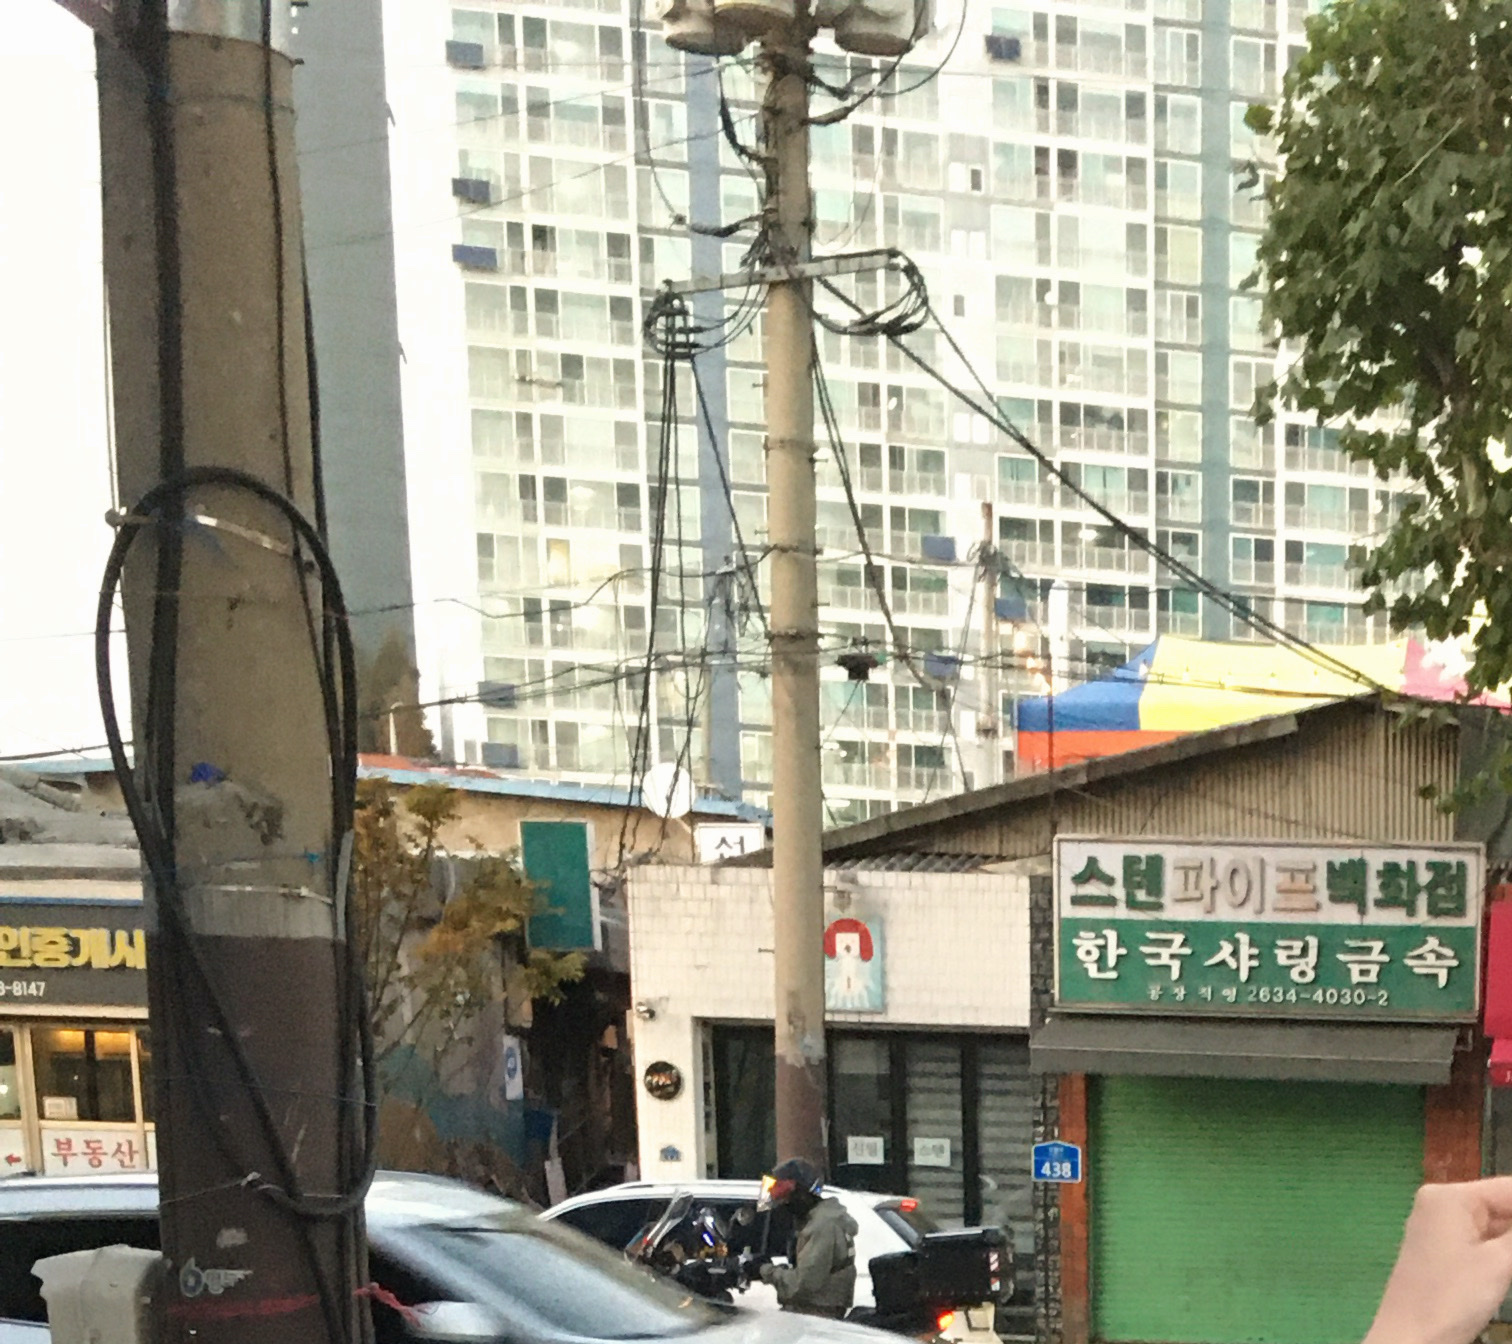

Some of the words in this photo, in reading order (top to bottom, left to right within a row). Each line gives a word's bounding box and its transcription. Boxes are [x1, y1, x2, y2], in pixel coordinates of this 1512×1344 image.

[1246, 985, 1390, 1007] 2634-4030-2
[51, 1137, 140, 1169] 부동산
[1040, 1161, 1072, 1178] 438
